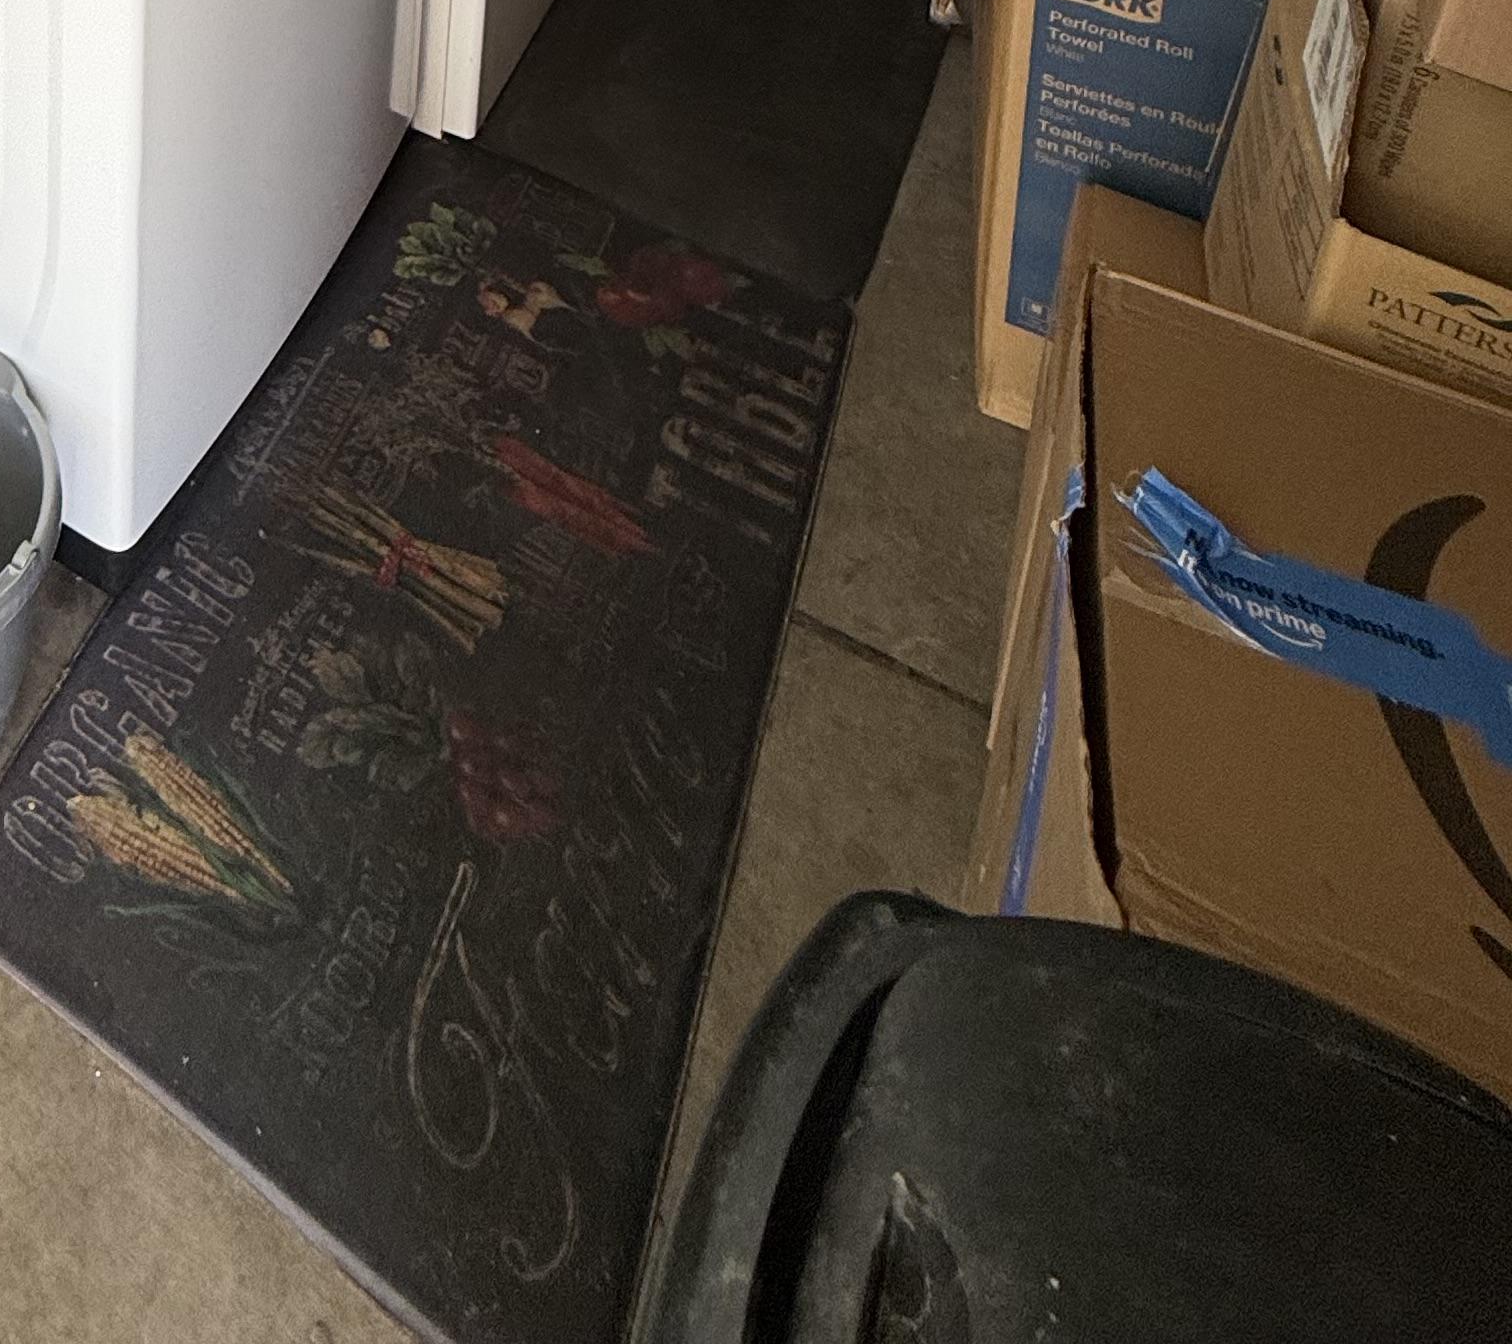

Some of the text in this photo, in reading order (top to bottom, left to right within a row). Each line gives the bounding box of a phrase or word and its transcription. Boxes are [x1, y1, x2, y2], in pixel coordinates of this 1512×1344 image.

[1049, 27, 1104, 54] Towel
[1050, 10, 1193, 61] Perforated Roll
[1043, 73, 1135, 112] Serviettes
[1141, 107, 1164, 120] en
[1038, 119, 1104, 152] Toallas
[1036, 138, 1111, 171] en Rollo
[1219, 568, 1275, 600] now
[1246, 599, 1326, 640] prime
[3, 531, 251, 882] ORGANIC
